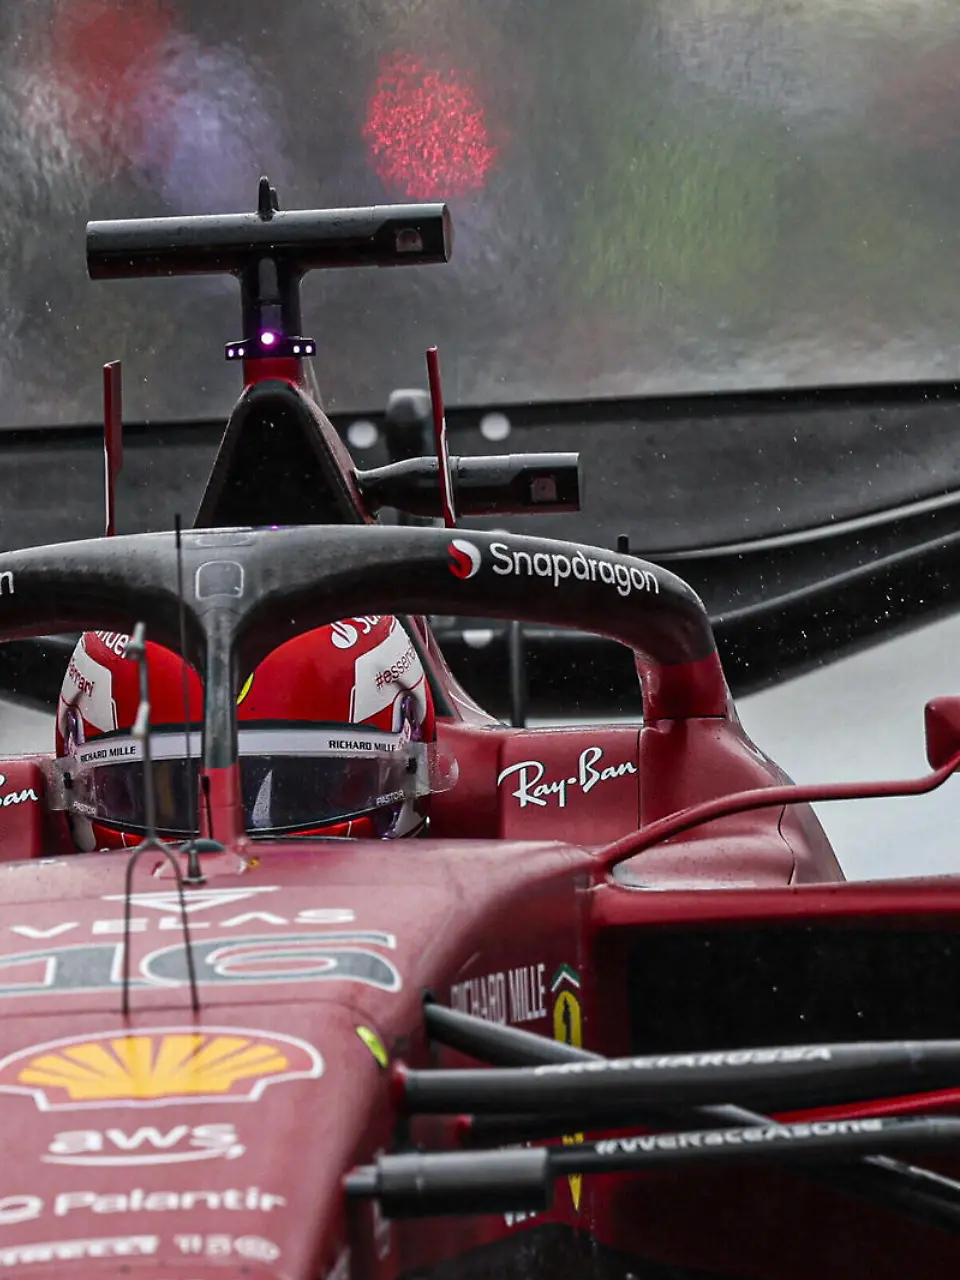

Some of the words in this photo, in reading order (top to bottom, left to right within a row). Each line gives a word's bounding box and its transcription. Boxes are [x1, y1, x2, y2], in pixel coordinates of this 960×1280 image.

[490, 542, 659, 596] Snapdragon
[109, 746, 136, 758] MILLE
[328, 740, 371, 751] RICHARD
[11, 907, 355, 939] VELAS
[508, 963, 547, 1023] MILLE
[49, 1123, 238, 1154] aws
[54, 1186, 288, 1217] Palantir
